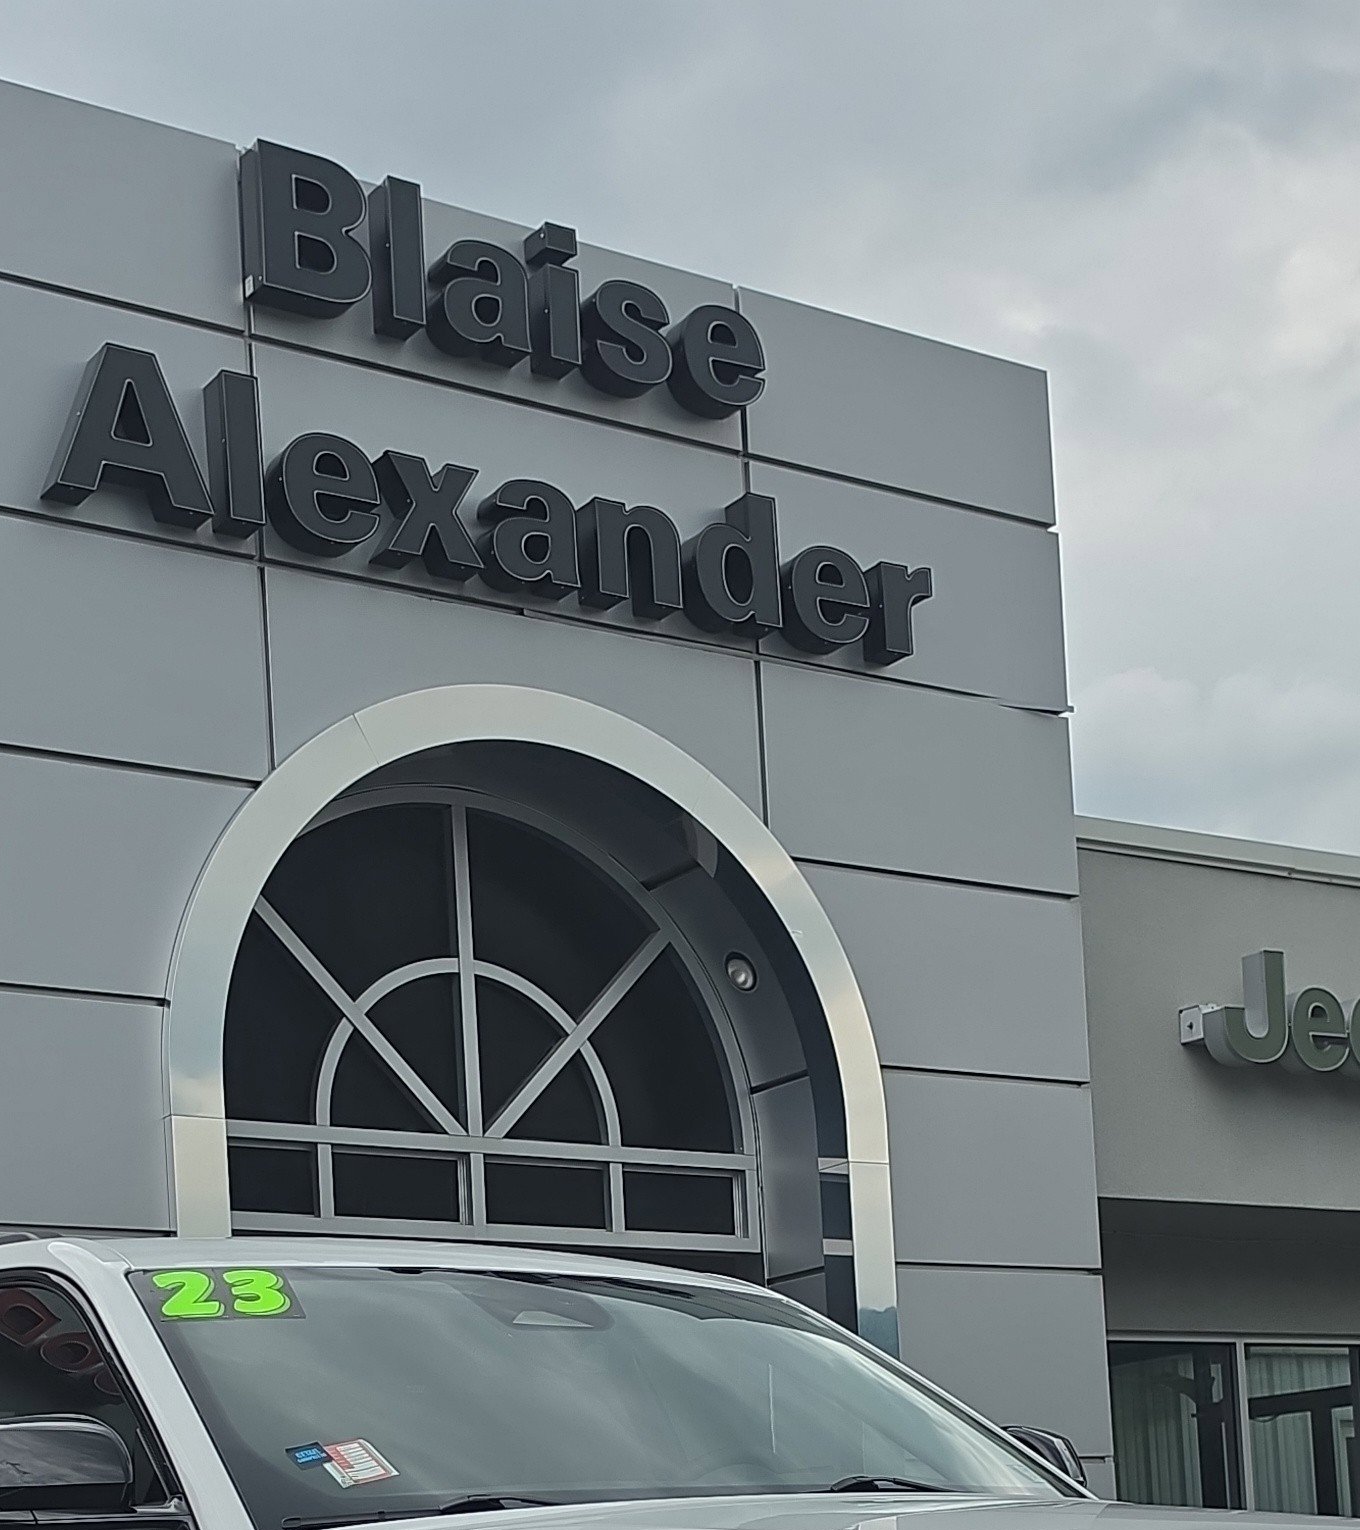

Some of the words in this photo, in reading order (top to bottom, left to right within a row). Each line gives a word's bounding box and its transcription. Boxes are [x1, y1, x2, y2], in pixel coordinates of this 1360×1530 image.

[241, 137, 767, 420] Blaise
[41, 341, 933, 667] Alexander
[151, 1269, 291, 1318] 23
